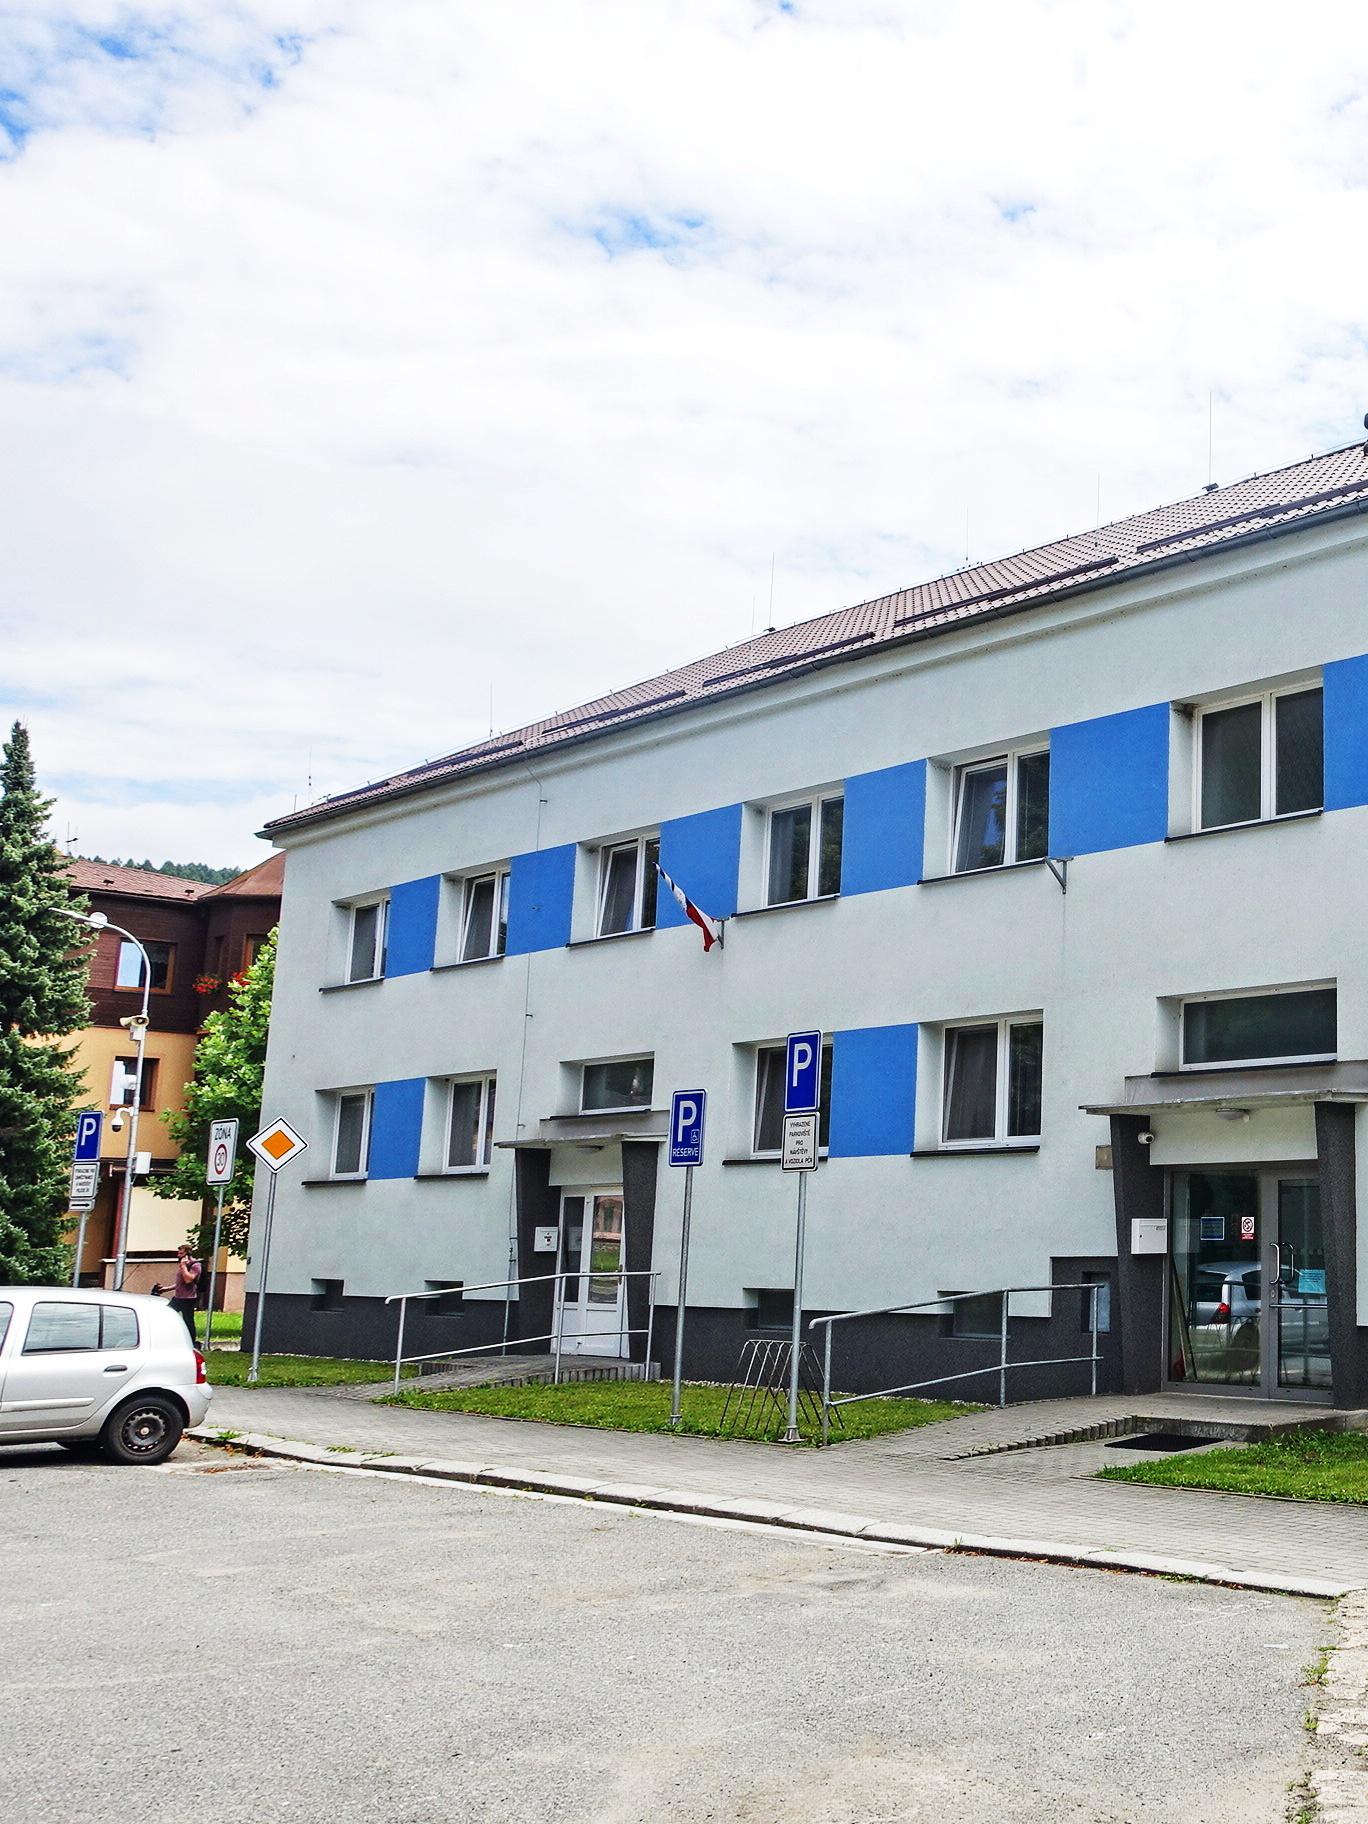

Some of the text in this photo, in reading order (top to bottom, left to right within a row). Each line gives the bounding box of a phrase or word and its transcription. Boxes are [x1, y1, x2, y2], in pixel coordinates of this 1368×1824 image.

[793, 1042, 813, 1088] P
[80, 1118, 97, 1146] P
[677, 1100, 698, 1142] P
